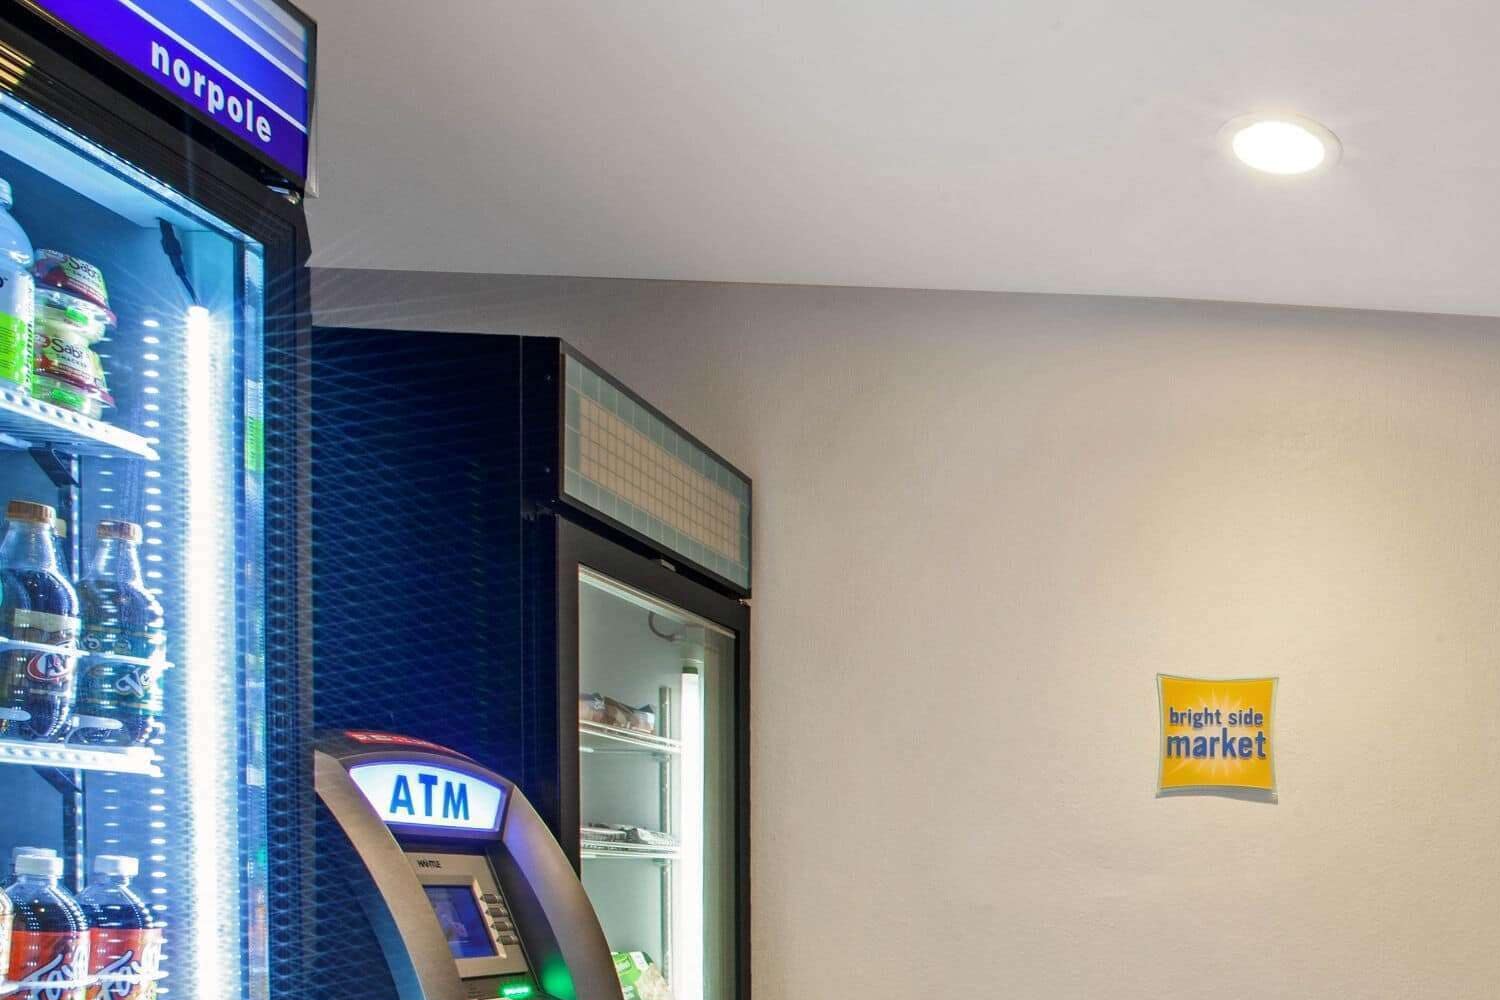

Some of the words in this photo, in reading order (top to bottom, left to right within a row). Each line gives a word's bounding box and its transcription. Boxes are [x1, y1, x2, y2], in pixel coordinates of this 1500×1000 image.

[151, 41, 272, 143] norpole
[1169, 705, 1222, 729] bright
[1228, 706, 1264, 726] side
[1166, 726, 1267, 759] market
[389, 773, 471, 821] ATM
